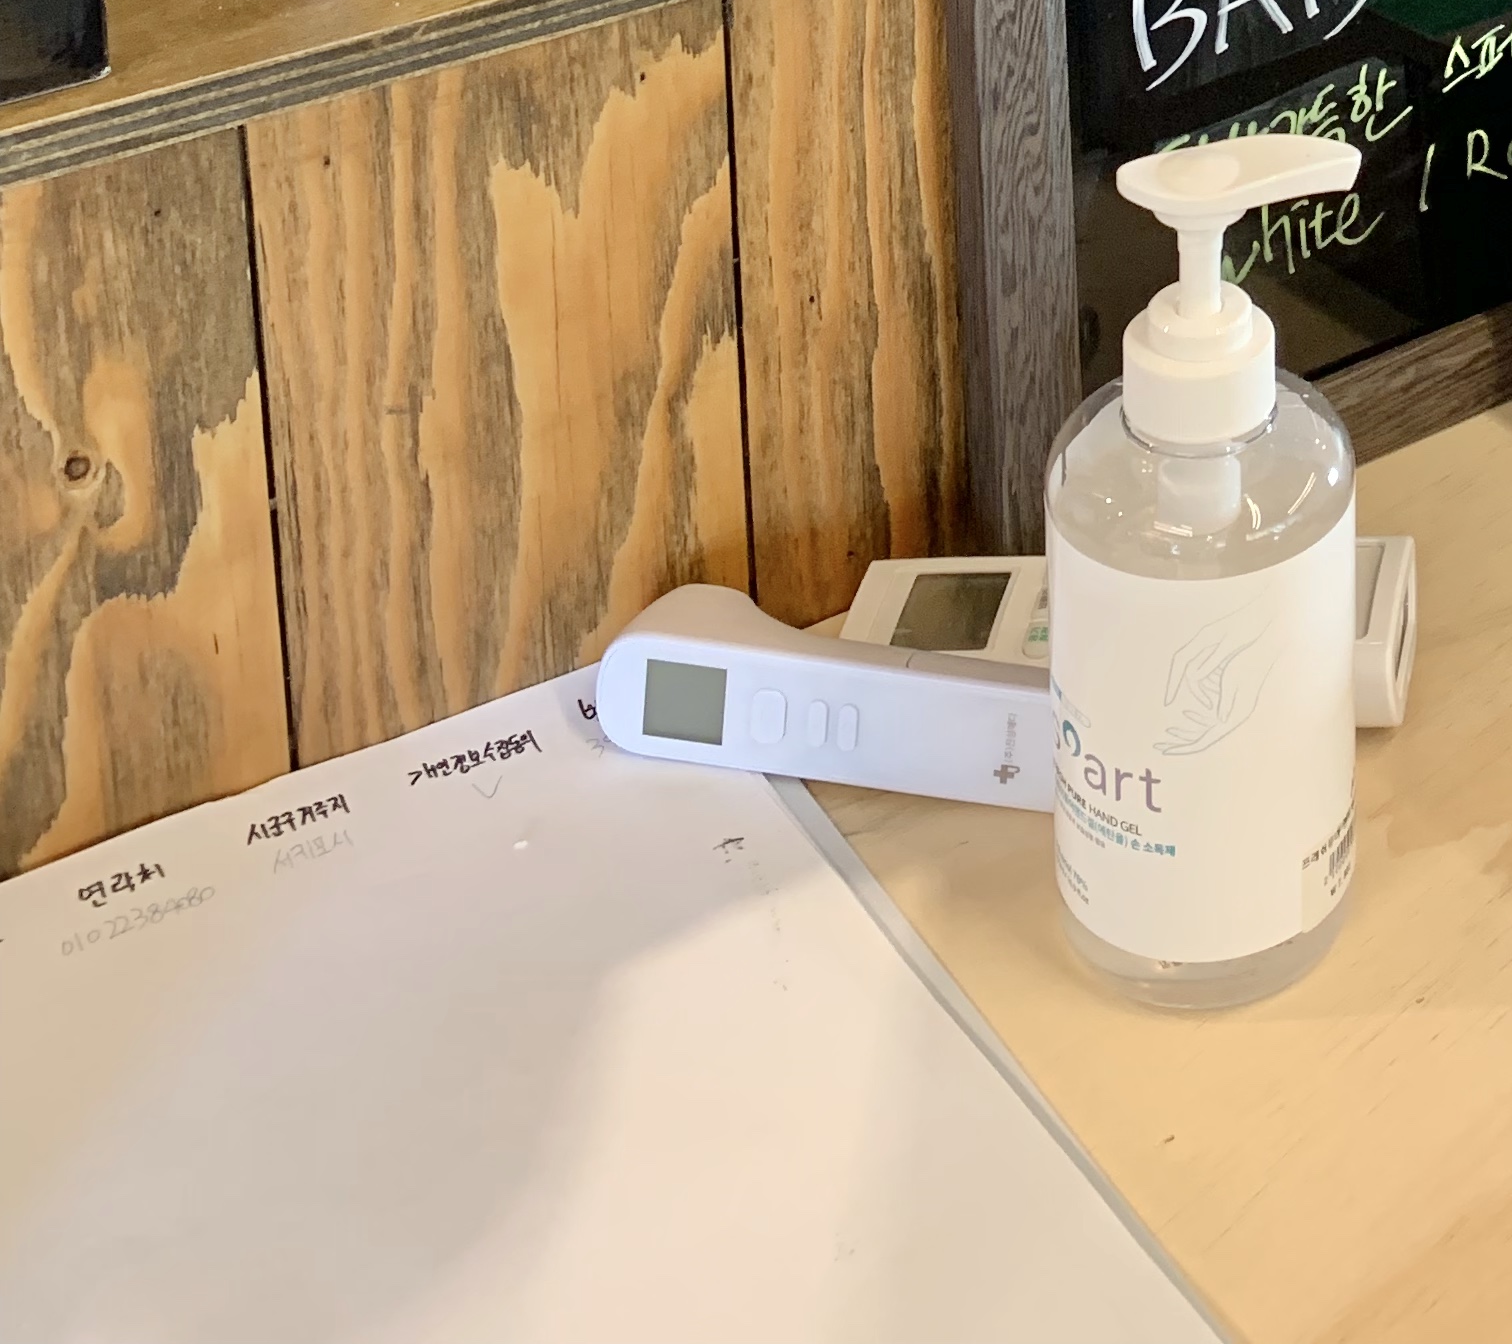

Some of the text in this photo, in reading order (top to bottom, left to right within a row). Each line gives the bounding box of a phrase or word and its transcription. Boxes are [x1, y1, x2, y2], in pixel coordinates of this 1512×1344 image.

[1068, 784, 1087, 811] PURE
[1089, 798, 1118, 828] HAND
[1120, 820, 1142, 837] GEL
